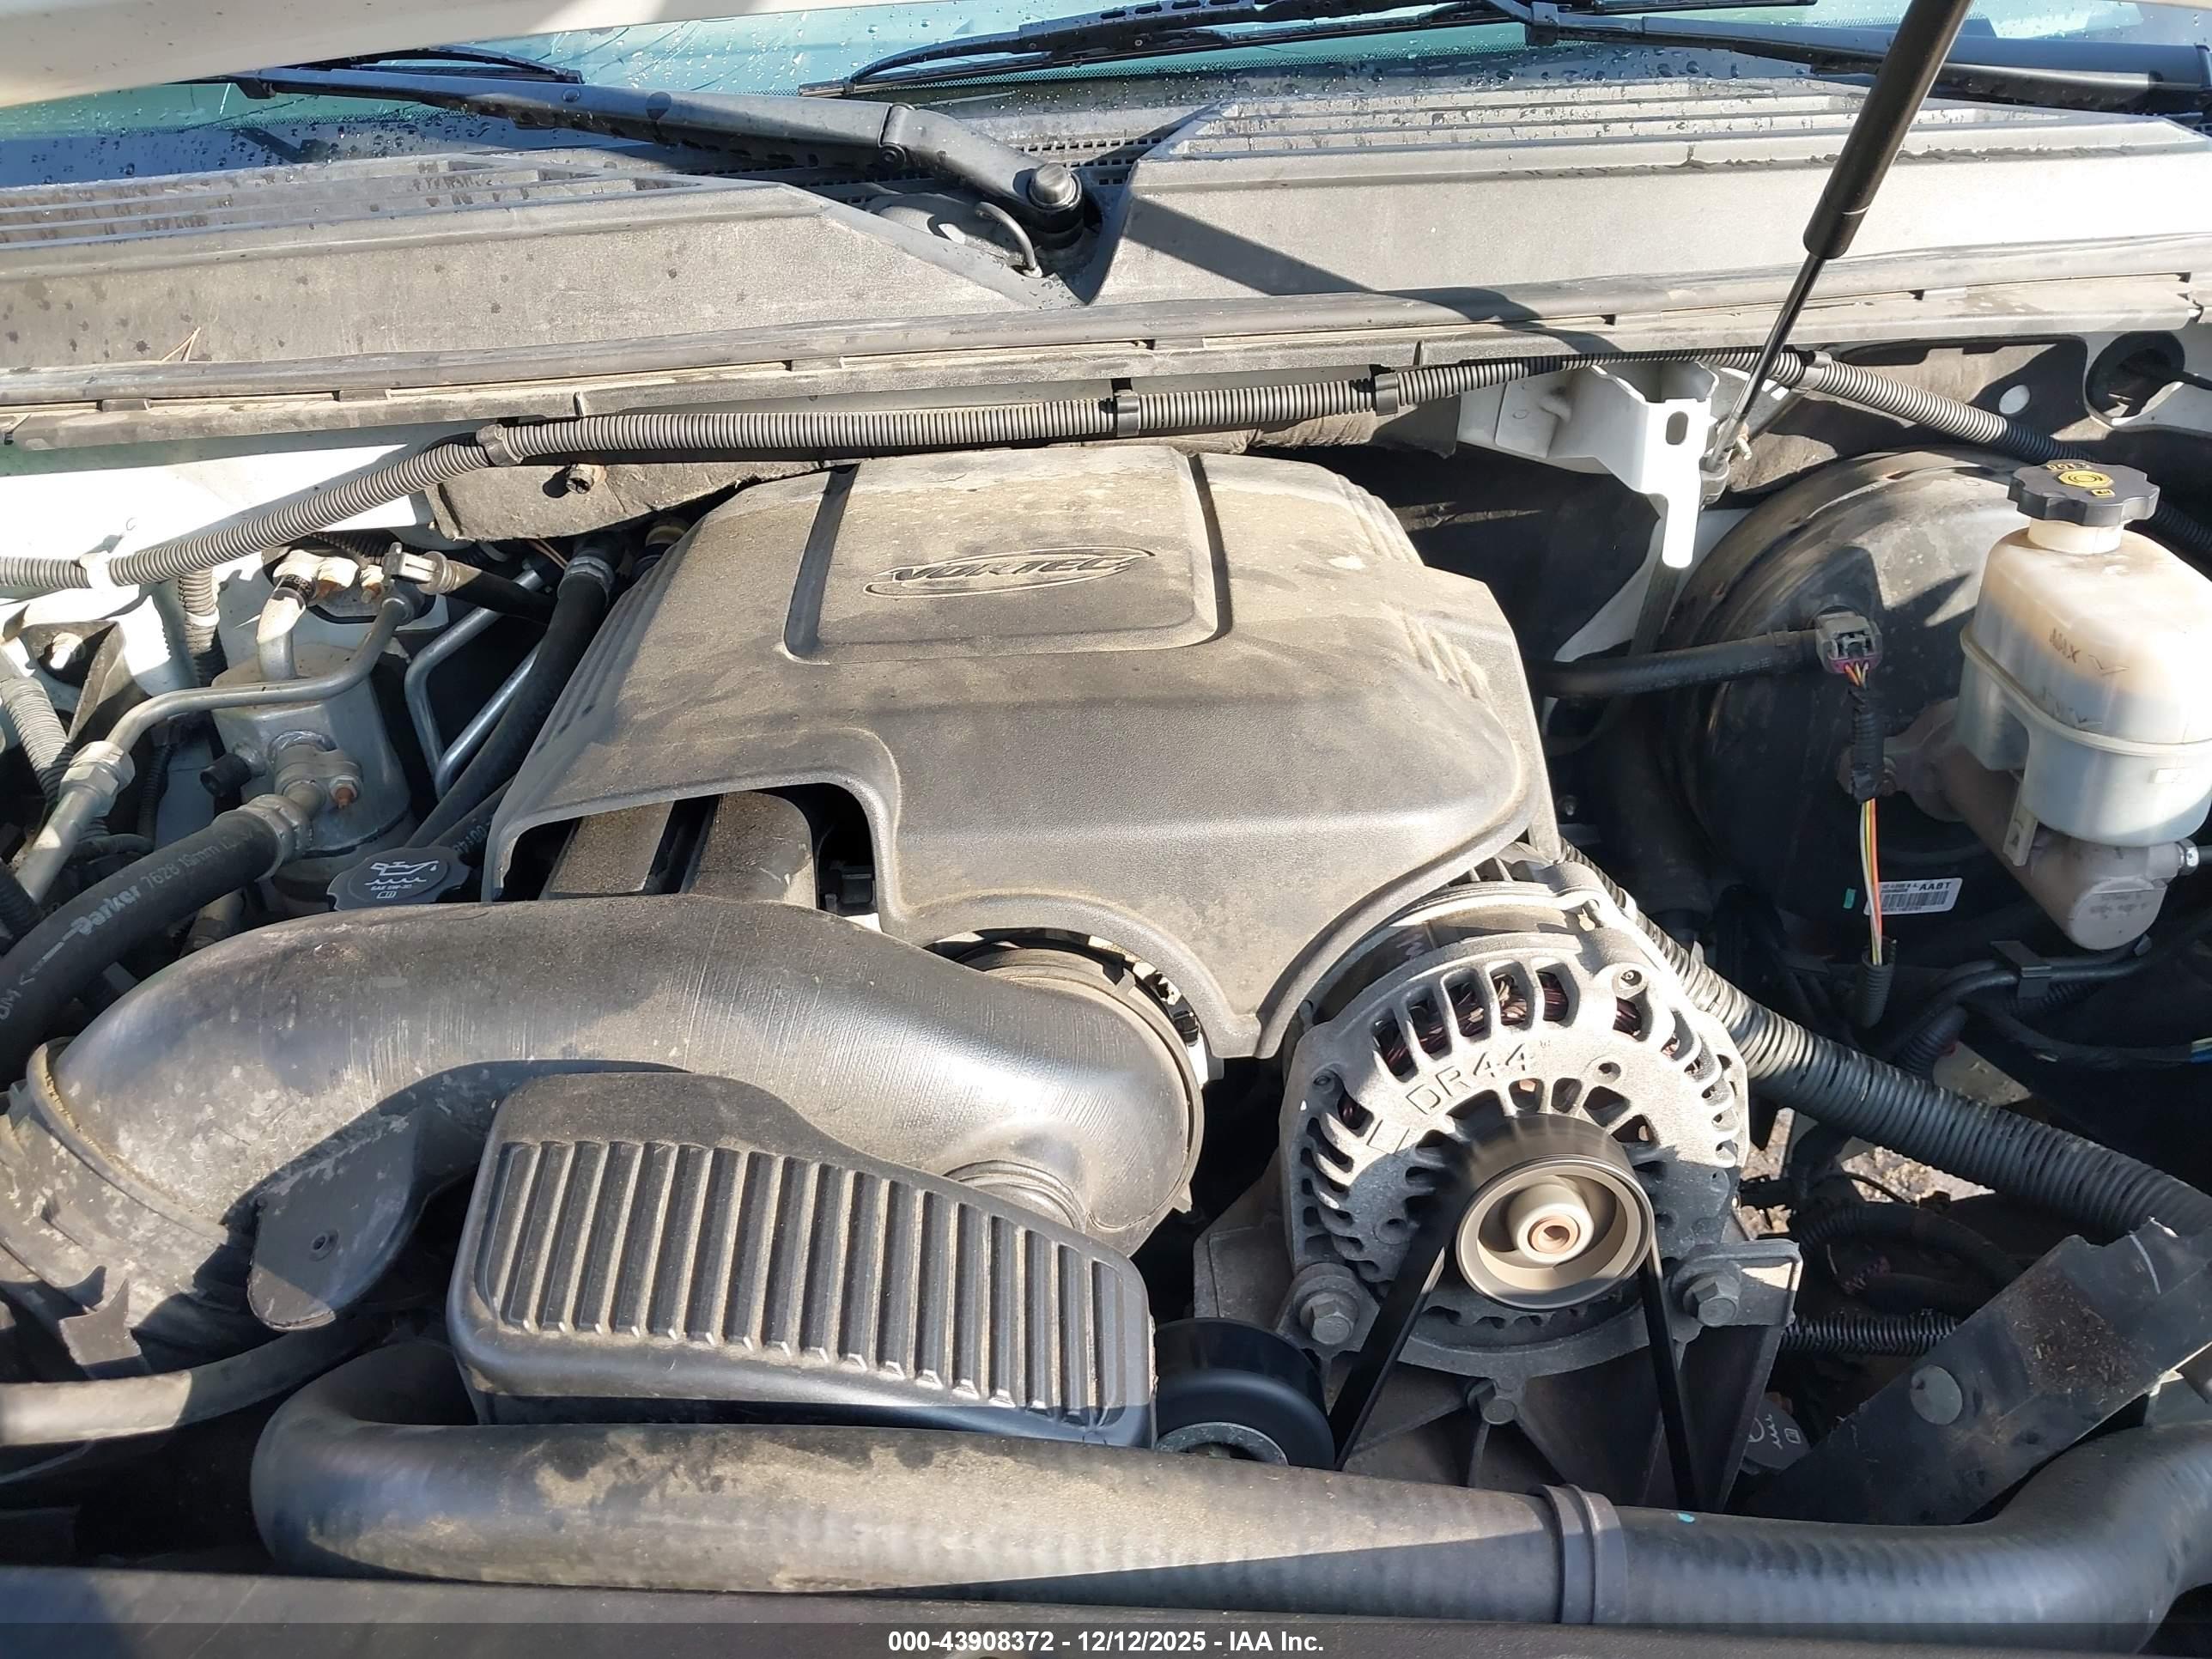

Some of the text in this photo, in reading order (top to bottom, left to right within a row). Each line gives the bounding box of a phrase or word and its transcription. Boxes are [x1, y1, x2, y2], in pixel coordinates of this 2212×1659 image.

[891, 556, 1118, 581] VORTEC
[70, 884, 142, 936] Parker
[1405, 1042, 1532, 1115] DR44
